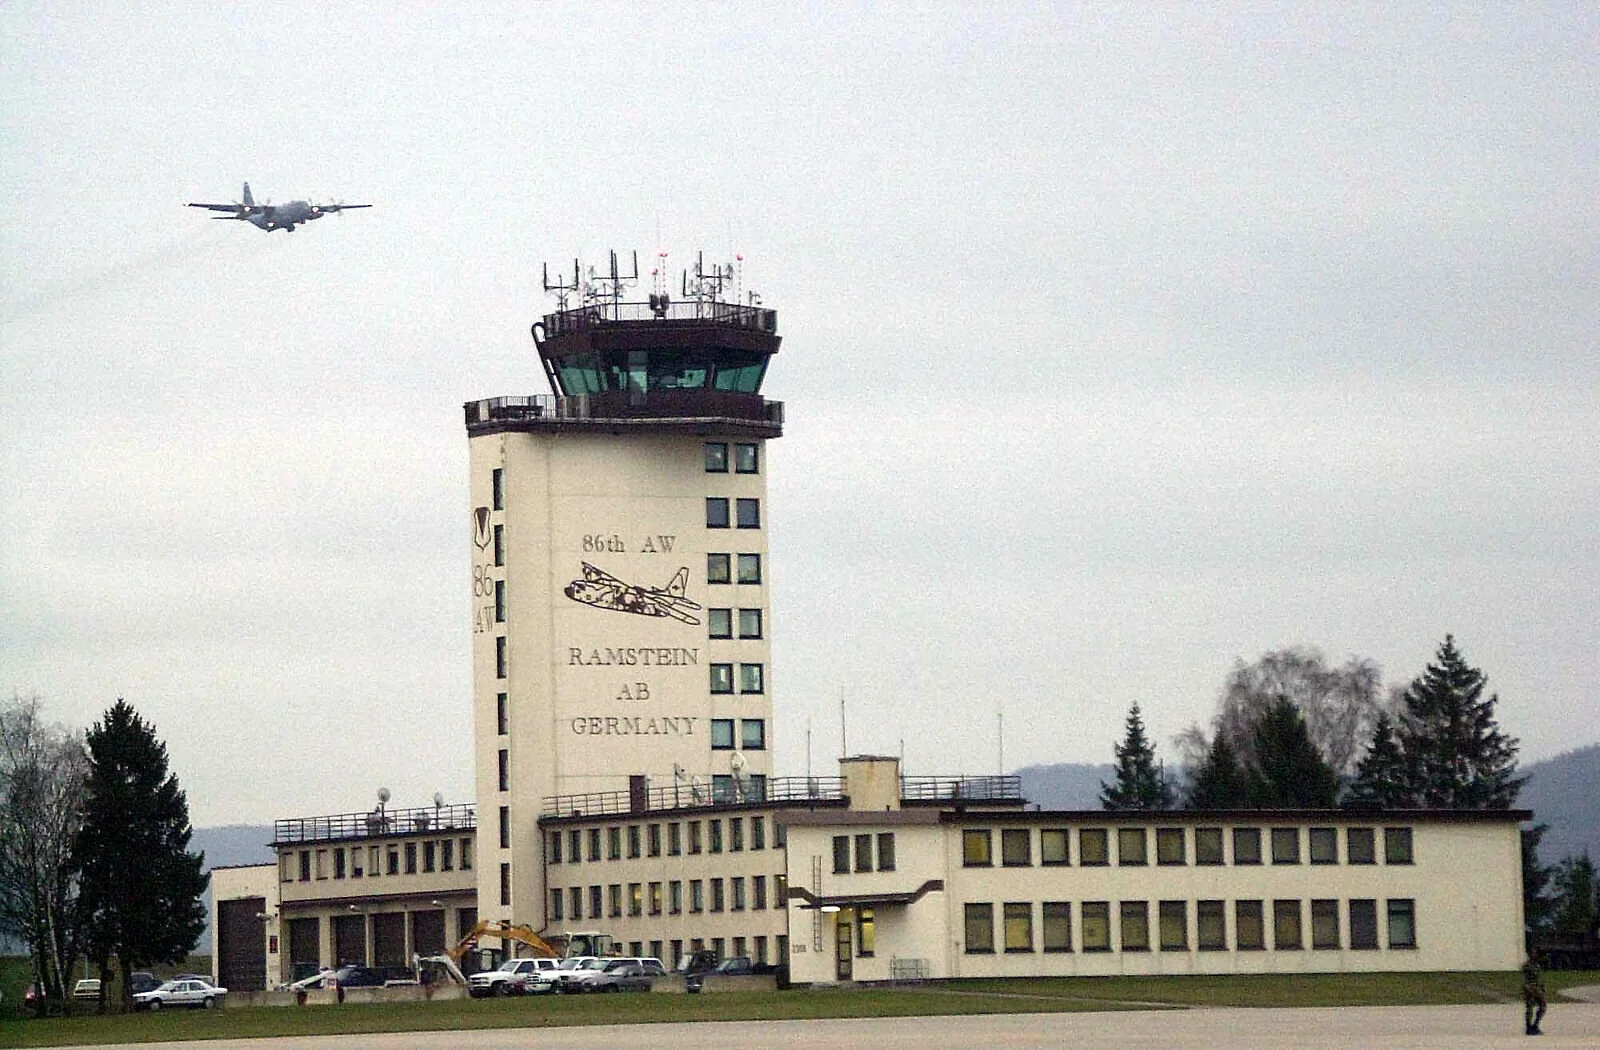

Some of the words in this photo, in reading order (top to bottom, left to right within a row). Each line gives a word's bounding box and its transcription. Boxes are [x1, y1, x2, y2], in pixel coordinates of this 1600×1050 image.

[583, 535, 625, 552] 86th
[642, 536, 675, 552] AW
[474, 564, 493, 597] 86
[474, 606, 494, 632] AW
[569, 648, 699, 666] RAMSTEIN
[617, 683, 650, 700] AB
[571, 717, 698, 735] GERMANY
